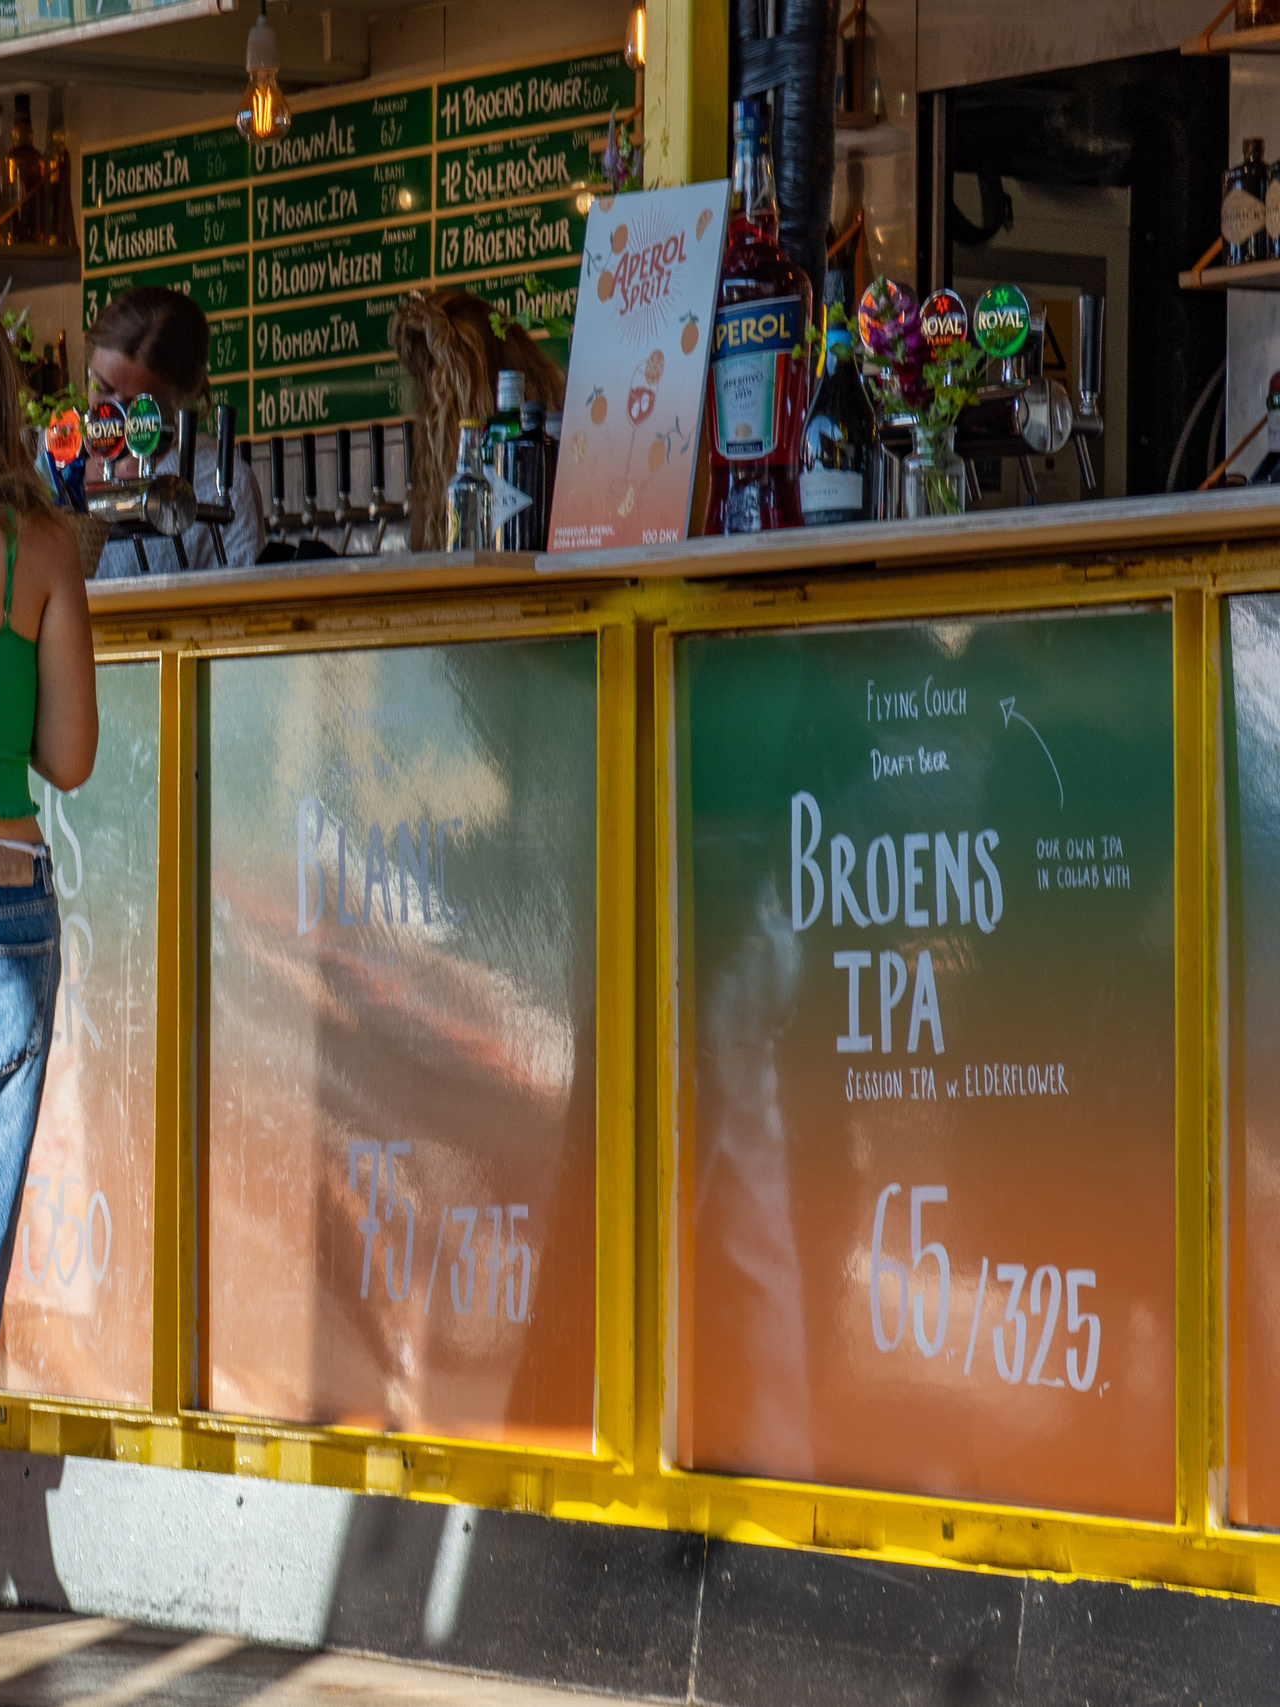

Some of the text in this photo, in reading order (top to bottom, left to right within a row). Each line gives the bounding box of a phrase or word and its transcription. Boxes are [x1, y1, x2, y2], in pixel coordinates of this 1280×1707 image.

[440, 91, 460, 136] 11
[462, 85, 524, 126] BROENS
[325, 115, 356, 157] ALE
[105, 159, 162, 198] BROENS
[163, 150, 190, 187] IPA
[440, 160, 462, 203] 12
[465, 157, 526, 200] SOLERO
[527, 145, 570, 190] SOUR
[257, 195, 269, 238] 7
[272, 195, 327, 233] MOSAIC
[327, 186, 358, 221] IPA
[89, 224, 103, 264] 2
[104, 222, 177, 262] WEISSBIER
[441, 215, 572, 270] 13 BROENS SOUR
[609, 229, 687, 299] APEROL
[257, 257, 268, 299] 8
[327, 250, 382, 288] WEIZEN
[619, 268, 672, 316] SPRITZ
[257, 313, 359, 362] 9 BOMBAY IPA
[712, 313, 791, 355] PEROL
[921, 316, 963, 336] ROYAL
[978, 309, 1024, 330] ROYAL
[87, 421, 123, 438] ROYAL
[125, 417, 157, 434] ROYAL
[257, 388, 276, 428] 10
[279, 386, 329, 425] BLANC
[642, 528, 679, 545] 100 DKK
[867, 674, 967, 723] FLYING COUCH
[870, 746, 950, 781] DRAFT BEER
[296, 796, 468, 937] BLANC
[791, 789, 1004, 934] BROENS
[1036, 834, 1124, 861] OUR OWN IPA
[1037, 864, 1131, 892] IN COLLAB WITH
[833, 950, 945, 1055] IPA
[845, 1066, 903, 1103] SESSION
[910, 1067, 937, 1101] IPA
[965, 1062, 1069, 1098] ELDERFLOWER
